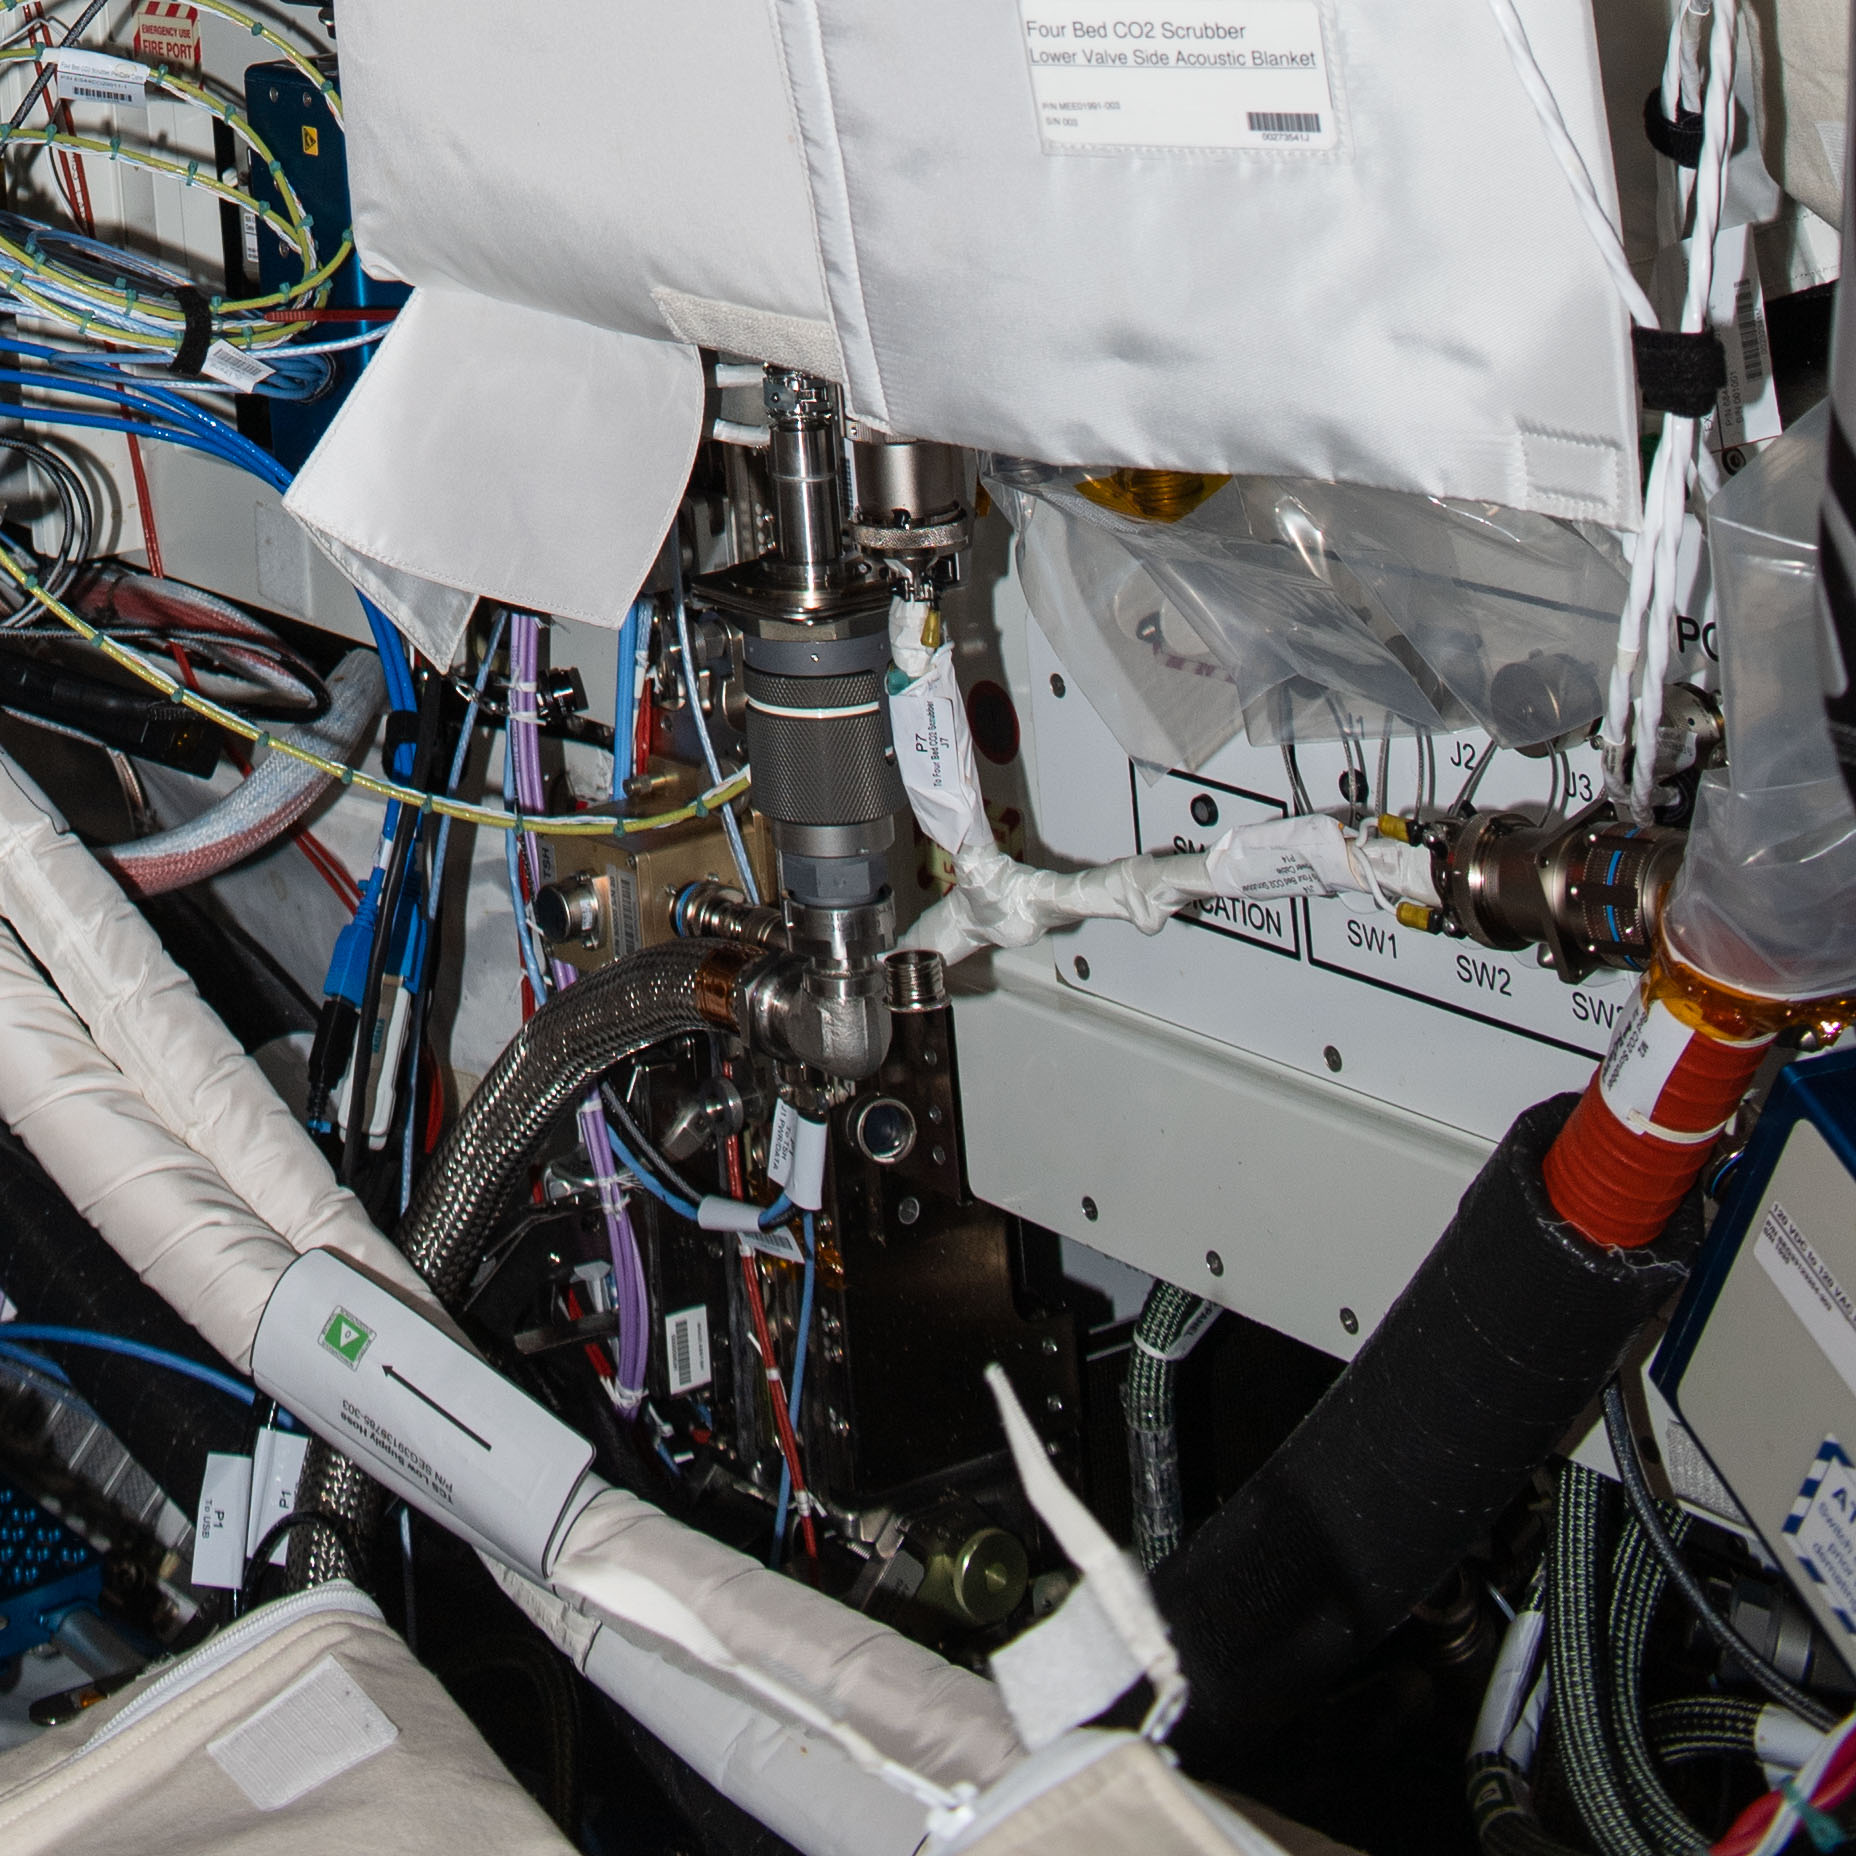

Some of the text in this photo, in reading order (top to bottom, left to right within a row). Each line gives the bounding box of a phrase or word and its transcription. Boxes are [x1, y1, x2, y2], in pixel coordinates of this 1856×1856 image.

[141, 23, 191, 38] EMERGENCY USE
[1026, 20, 1245, 40] Four Bed CO2 Scrubber
[142, 39, 192, 58] FIRE PORT
[1029, 47, 1315, 67] Lower Valve Side Acoustic Blanket
[927, 700, 936, 731] Scrubber
[916, 733, 926, 753] P7
[1449, 740, 1479, 769] J2
[934, 778, 941, 787] To
[542, 847, 550, 877] TSH
[1343, 919, 1401, 959] SW1
[1452, 953, 1516, 996] SW2
[338, 1411, 456, 1504] TCS Low Supply Hose
[199, 1498, 212, 1538] To USB
[212, 1510, 224, 1528] P1
[1813, 1502, 1856, 1554] Switch
[1824, 1541, 1856, 1578] prior
